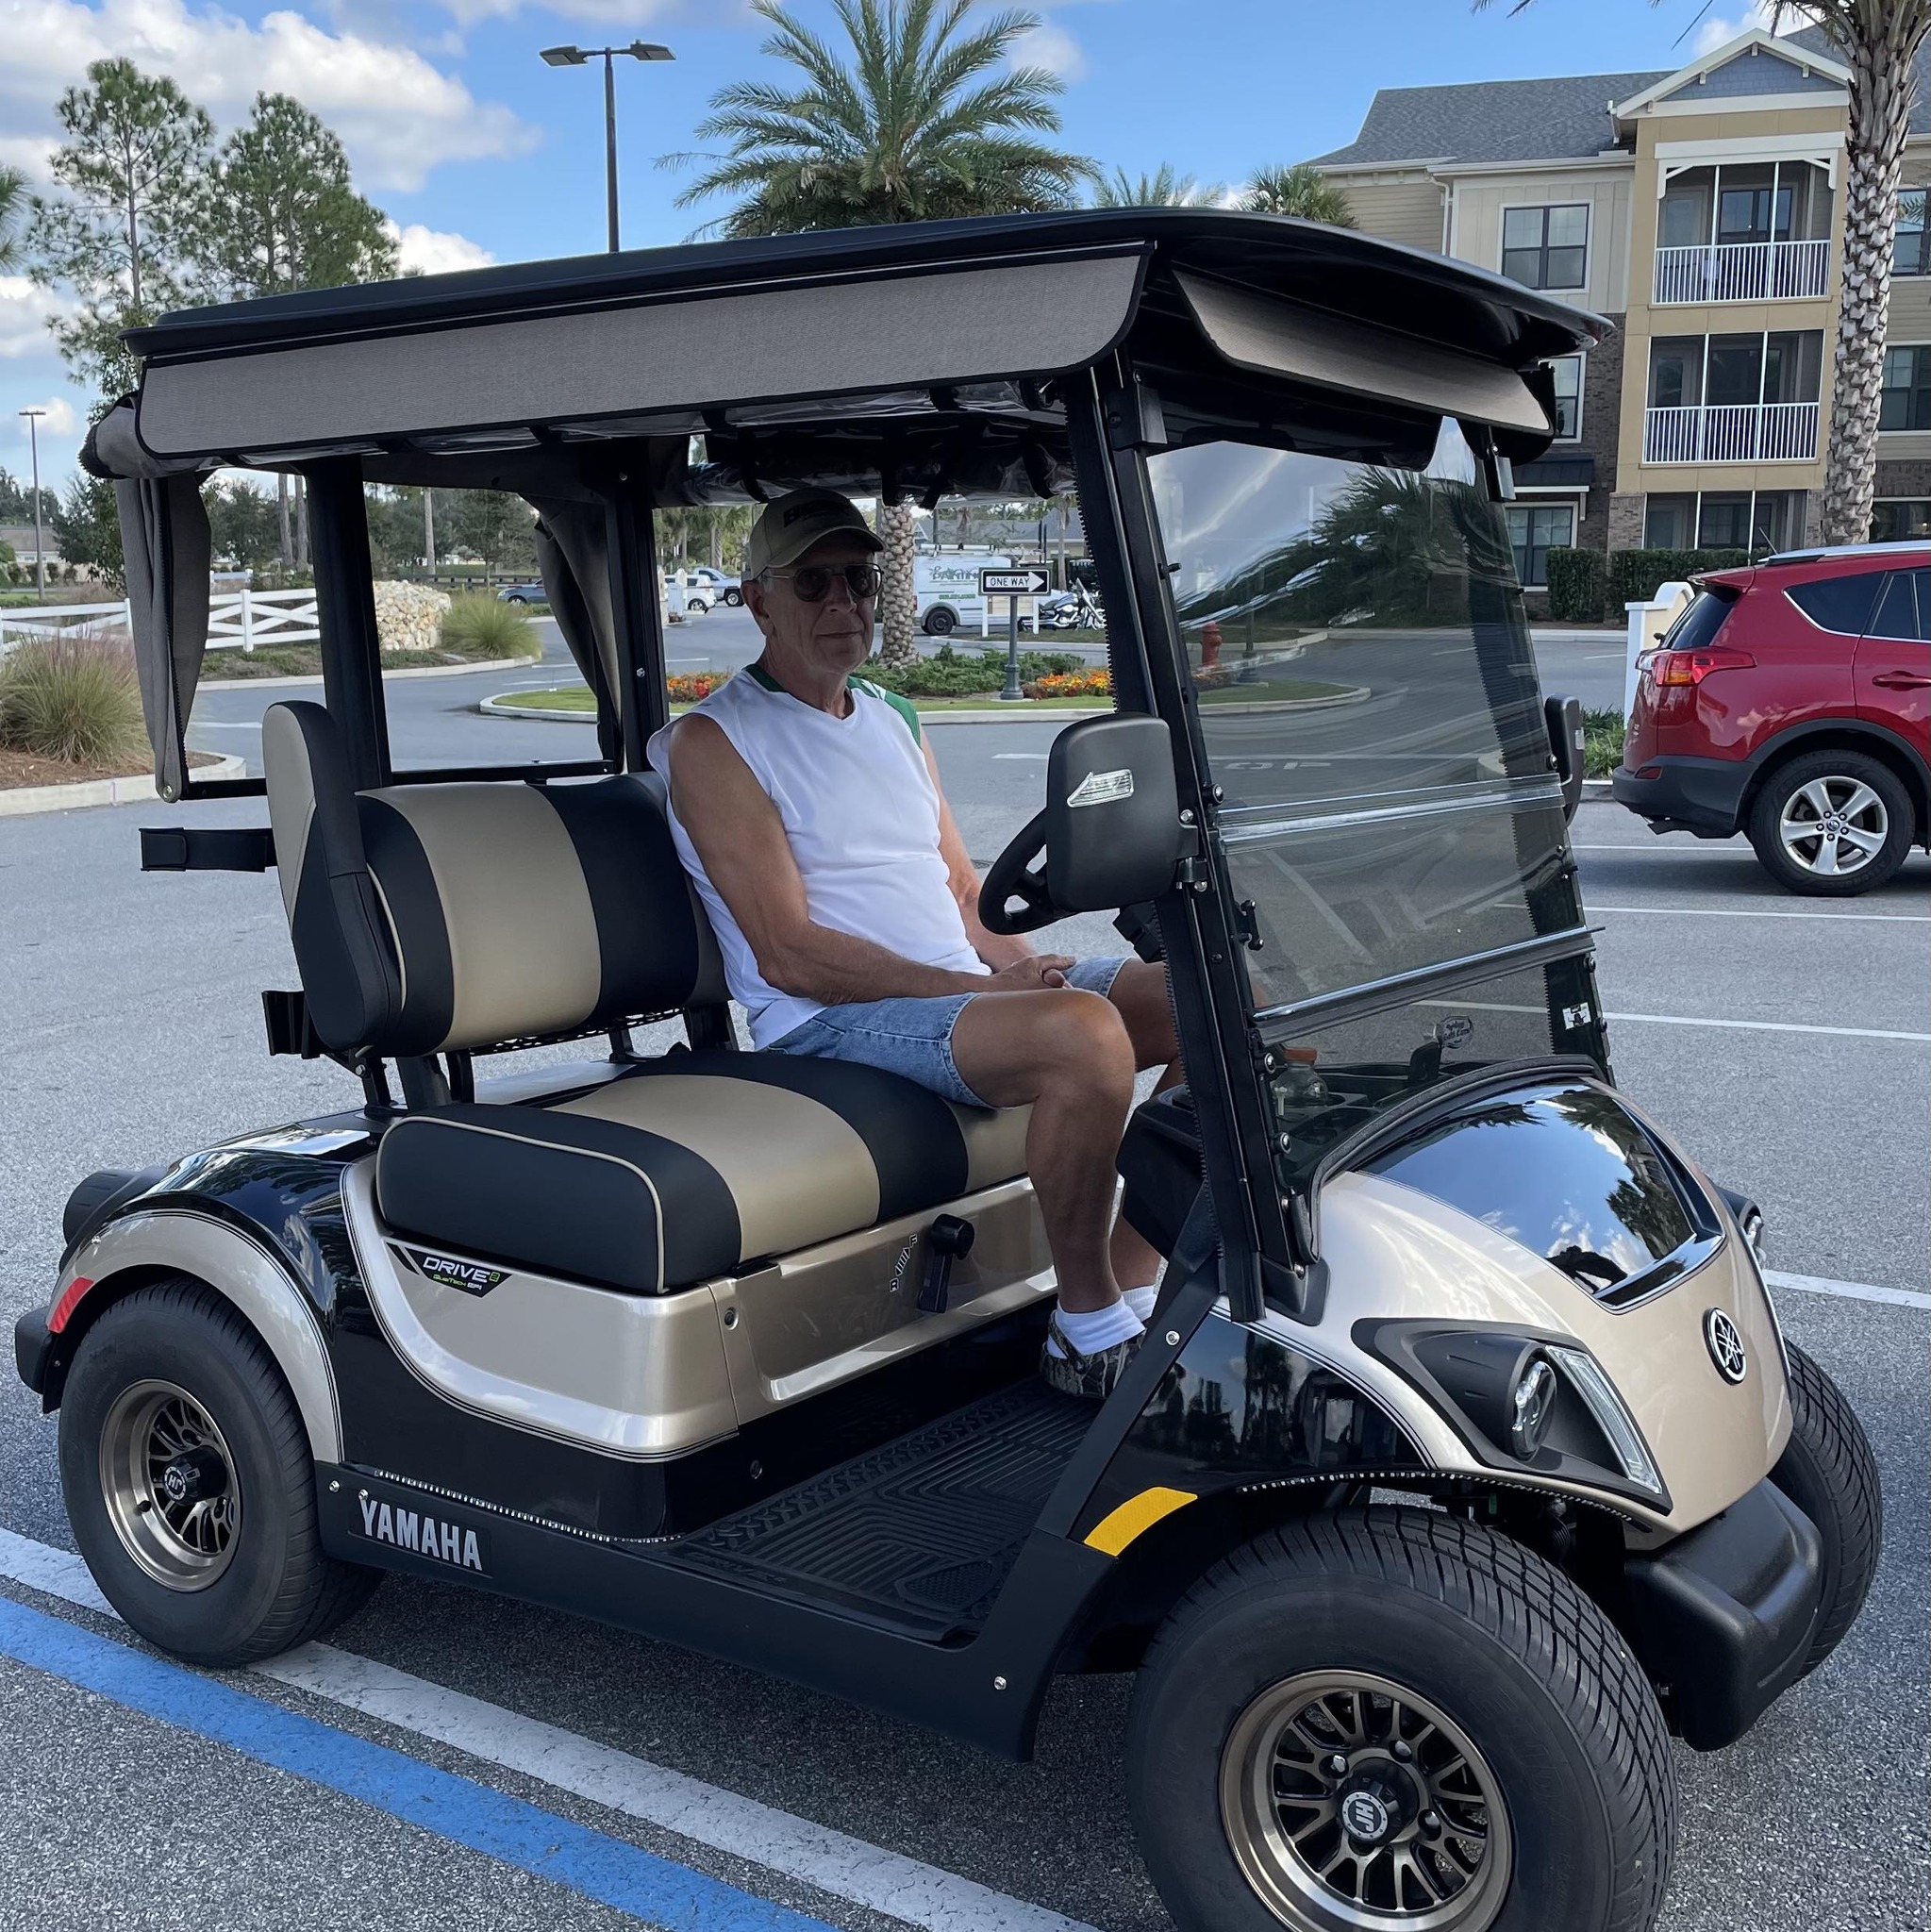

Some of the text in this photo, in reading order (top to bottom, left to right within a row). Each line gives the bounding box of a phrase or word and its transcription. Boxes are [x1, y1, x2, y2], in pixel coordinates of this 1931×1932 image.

[990, 577, 1029, 586] ONE WAY
[359, 1499, 483, 1572] YAMAHA
